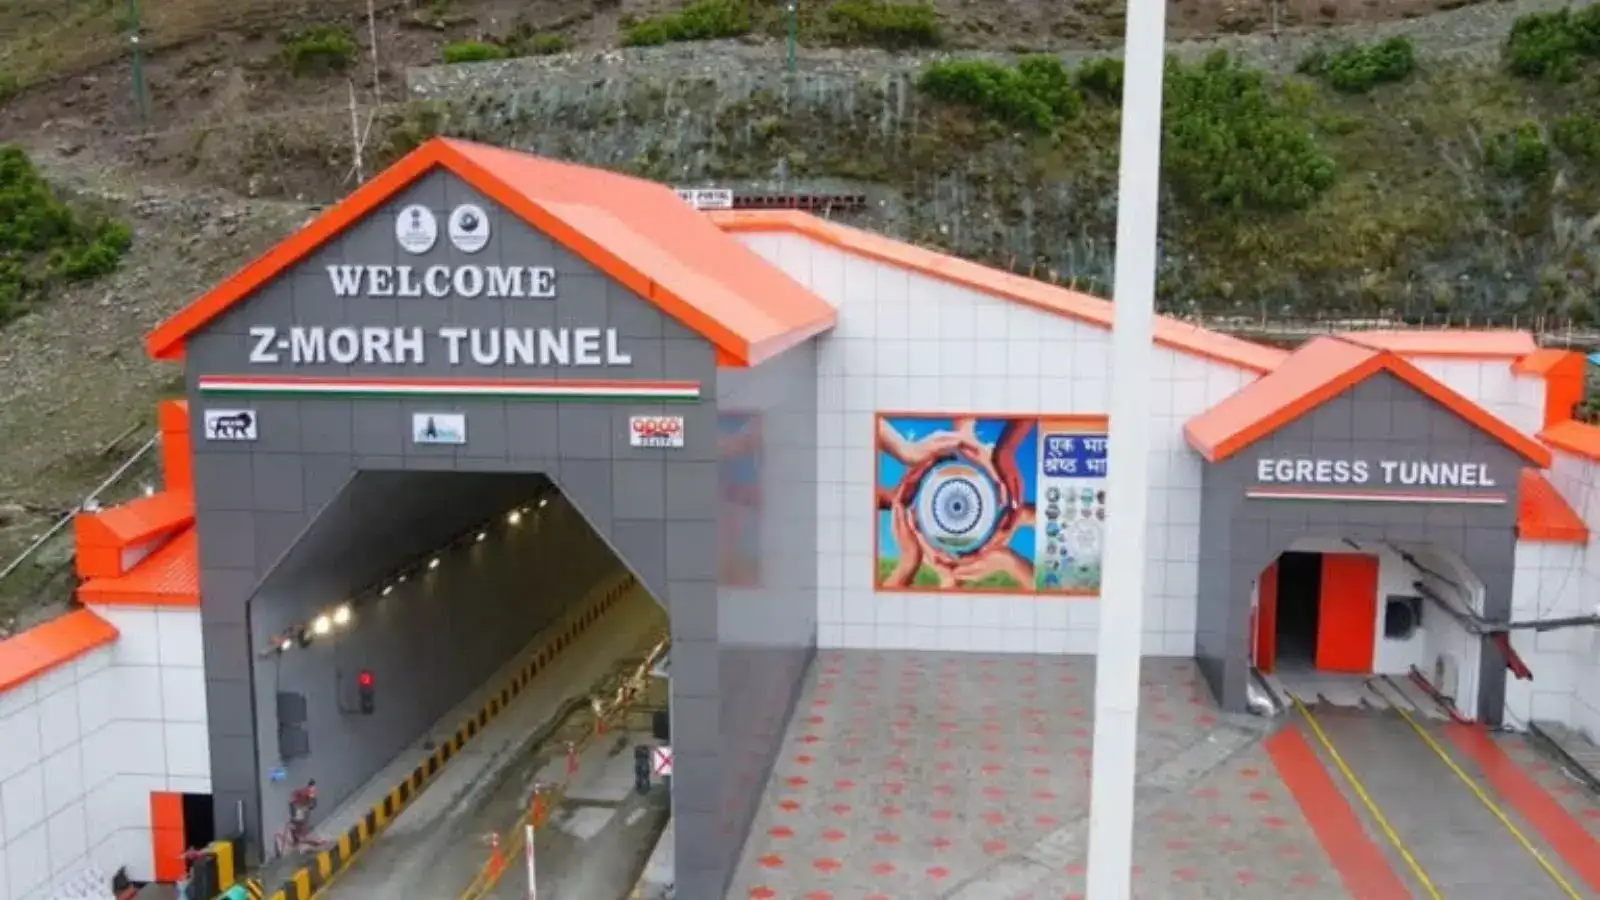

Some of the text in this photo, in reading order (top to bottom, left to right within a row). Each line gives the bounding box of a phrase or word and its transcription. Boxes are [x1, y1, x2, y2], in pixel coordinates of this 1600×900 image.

[327, 264, 556, 298] WELCOME
[249, 326, 632, 366] Z-MORH TUNNEL
[1049, 437, 1108, 453] एक भा
[1085, 458, 1107, 473] भा
[1257, 458, 1496, 487] EGRESS TUNNEL
